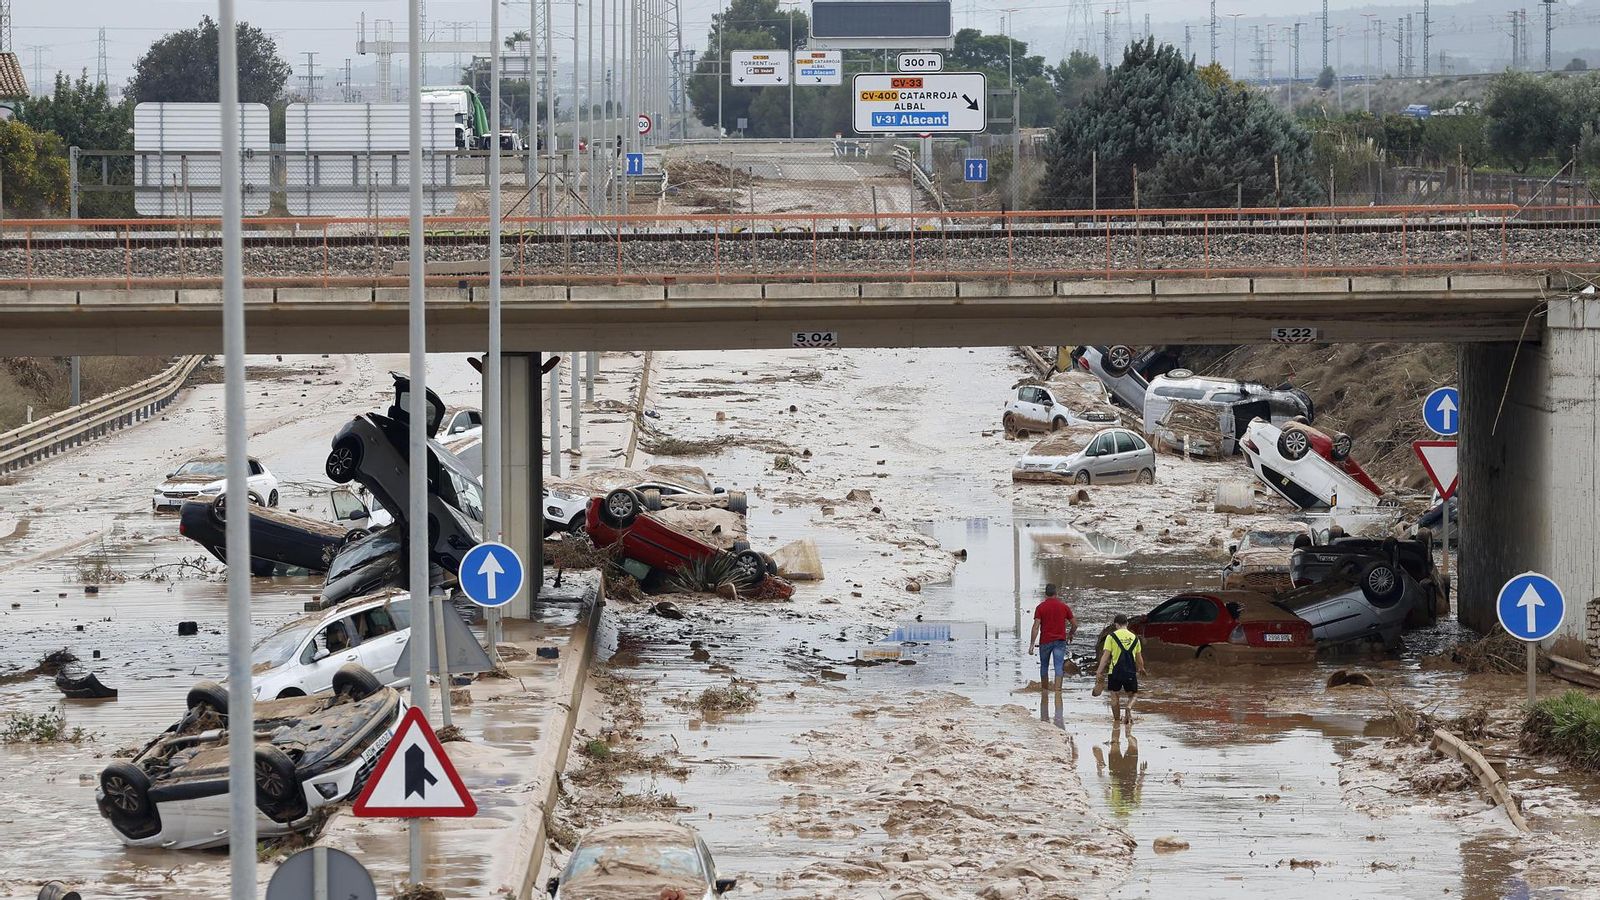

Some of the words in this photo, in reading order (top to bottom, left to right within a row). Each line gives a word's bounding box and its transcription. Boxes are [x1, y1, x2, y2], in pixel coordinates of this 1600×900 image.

[876, 116, 896, 124] V-31
[900, 115, 948, 125] Alacant
[797, 333, 833, 342] 5.04
[1278, 328, 1312, 338] 5.22
[376, 732, 390, 749] 2009
